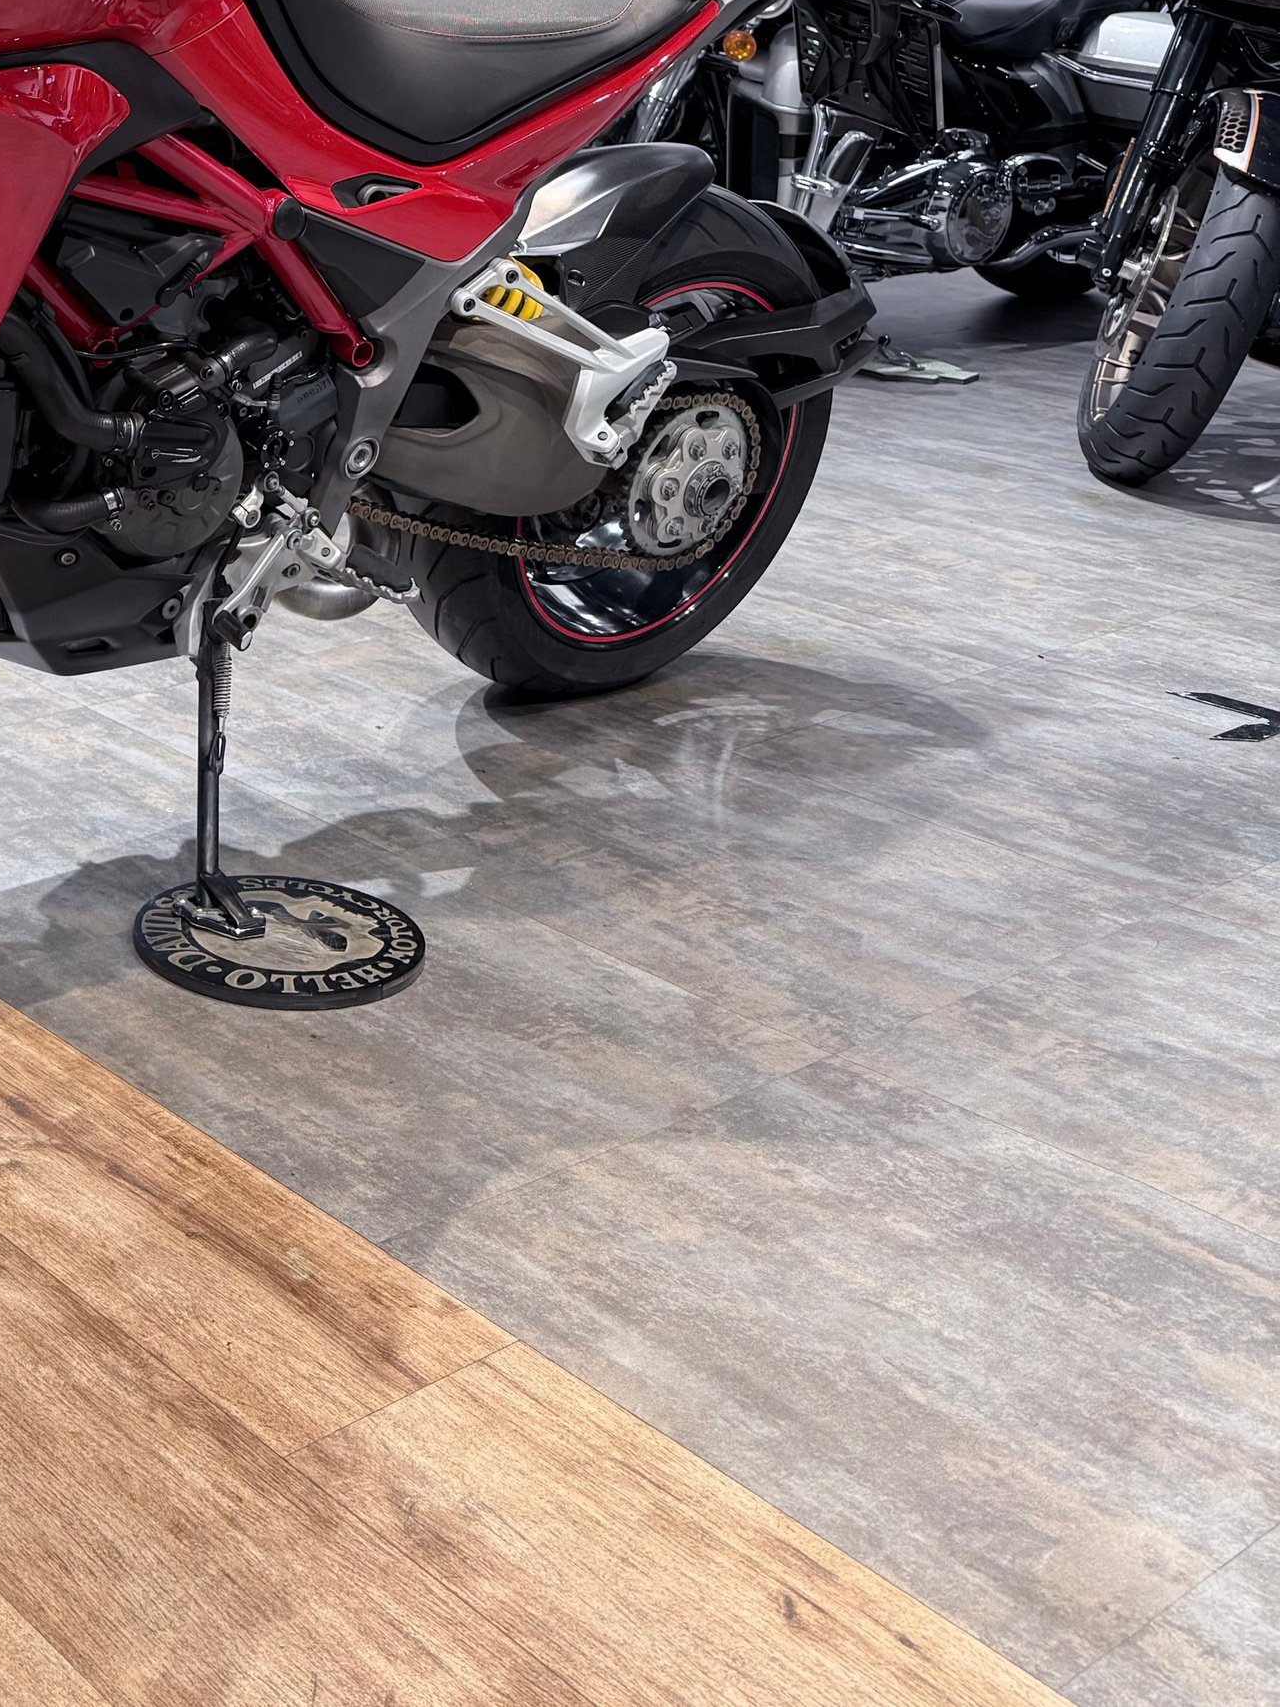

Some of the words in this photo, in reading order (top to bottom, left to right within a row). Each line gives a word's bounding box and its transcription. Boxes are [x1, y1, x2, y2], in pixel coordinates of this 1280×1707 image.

[141, 885, 218, 972] DAVIDSO
[237, 877, 418, 965] MOTORCYCLES
[224, 964, 393, 994] HELLO
